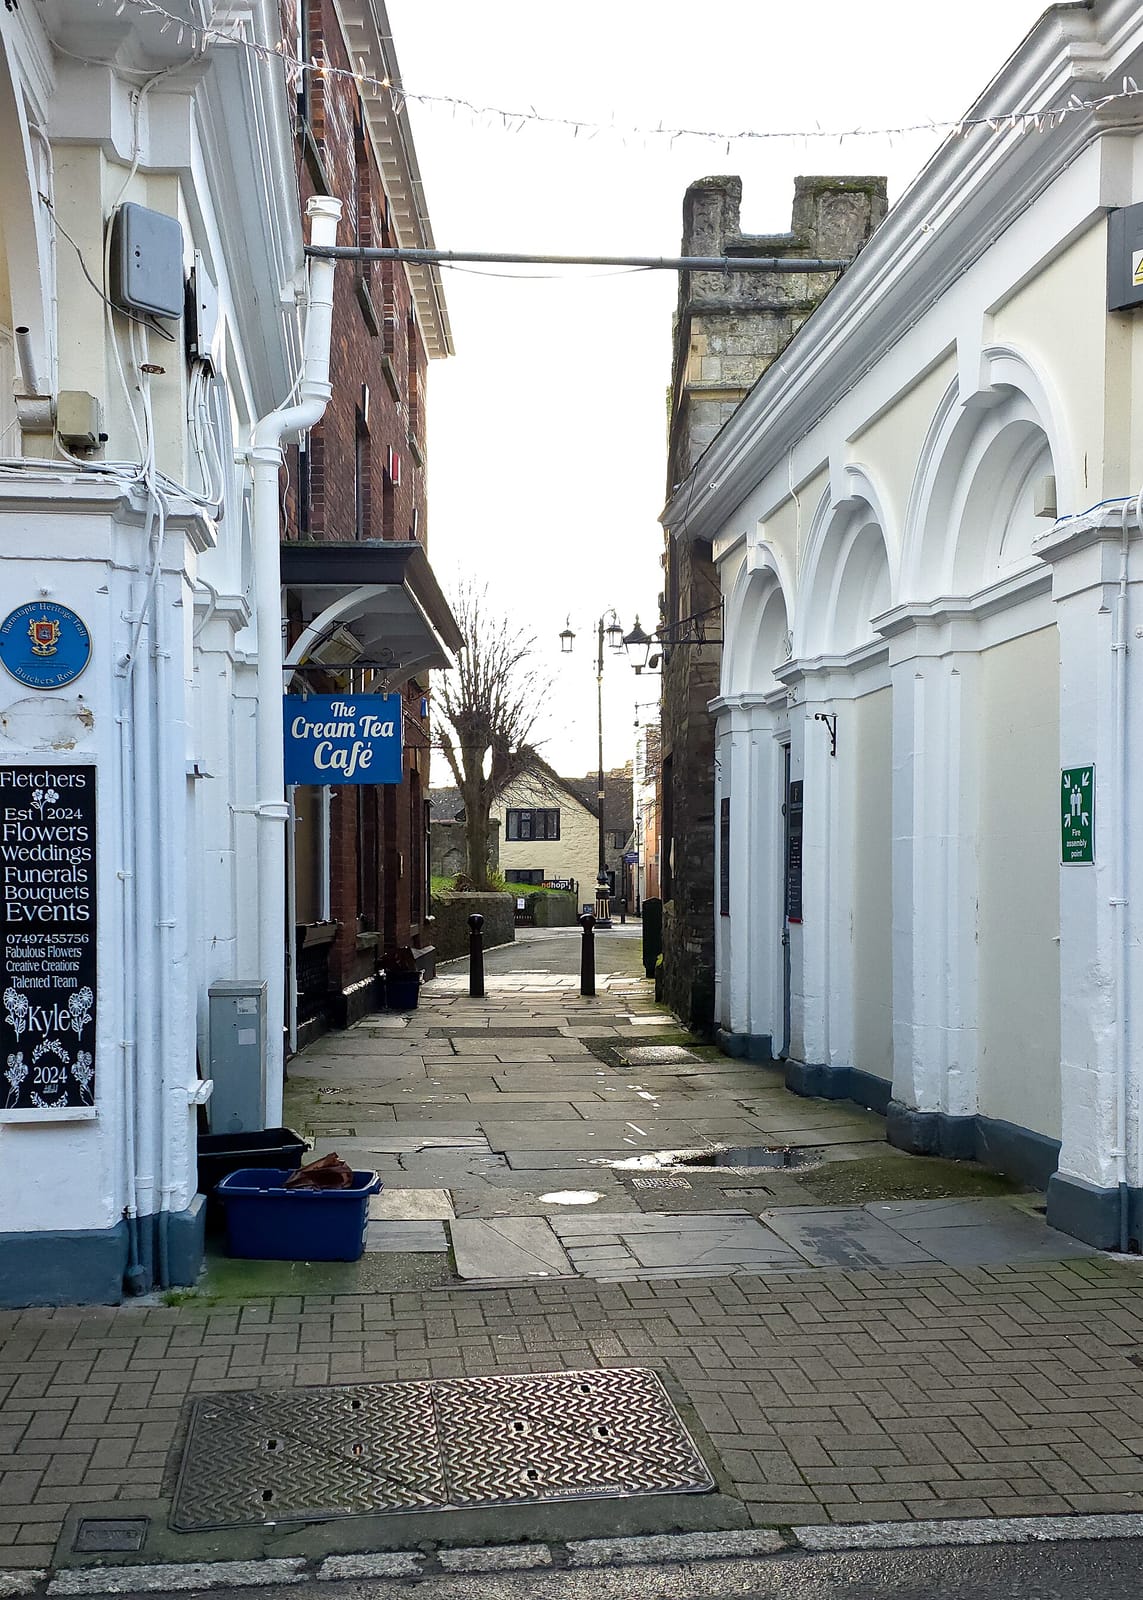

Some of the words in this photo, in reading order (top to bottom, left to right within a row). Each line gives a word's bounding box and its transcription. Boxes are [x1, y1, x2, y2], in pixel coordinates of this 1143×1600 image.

[2, 605, 36, 634] Barnstaple
[40, 603, 73, 620] Heritage
[72, 617, 88, 637] Trail
[15, 667, 54, 684] Butchers
[56, 669, 75, 682] Row
[330, 701, 356, 717] The
[291, 716, 356, 738] Cream
[359, 715, 394, 738] Tea
[313, 741, 373, 777] Café
[0, 770, 87, 788] Fletchers
[4, 808, 33, 821] Est
[47, 808, 83, 820] 2024
[3, 821, 89, 842] Flowers
[1067, 839, 1087, 848] assembly
[0, 844, 92, 865] Weddings
[1071, 850, 1082, 859] point
[4, 865, 88, 883] Funerals
[4, 885, 90, 903] Bouquets
[6, 902, 90, 922] Events
[6, 933, 90, 944] 07497455756
[5, 945, 46, 958] Fabulous
[47, 945, 82, 958] Flowers
[6, 960, 40, 972] Creative
[41, 959, 80, 972] Creations
[11, 974, 51, 988] Talented
[52, 975, 78, 988] Team
[28, 1003, 71, 1038] Kyle
[33, 1066, 68, 1084] 2024
